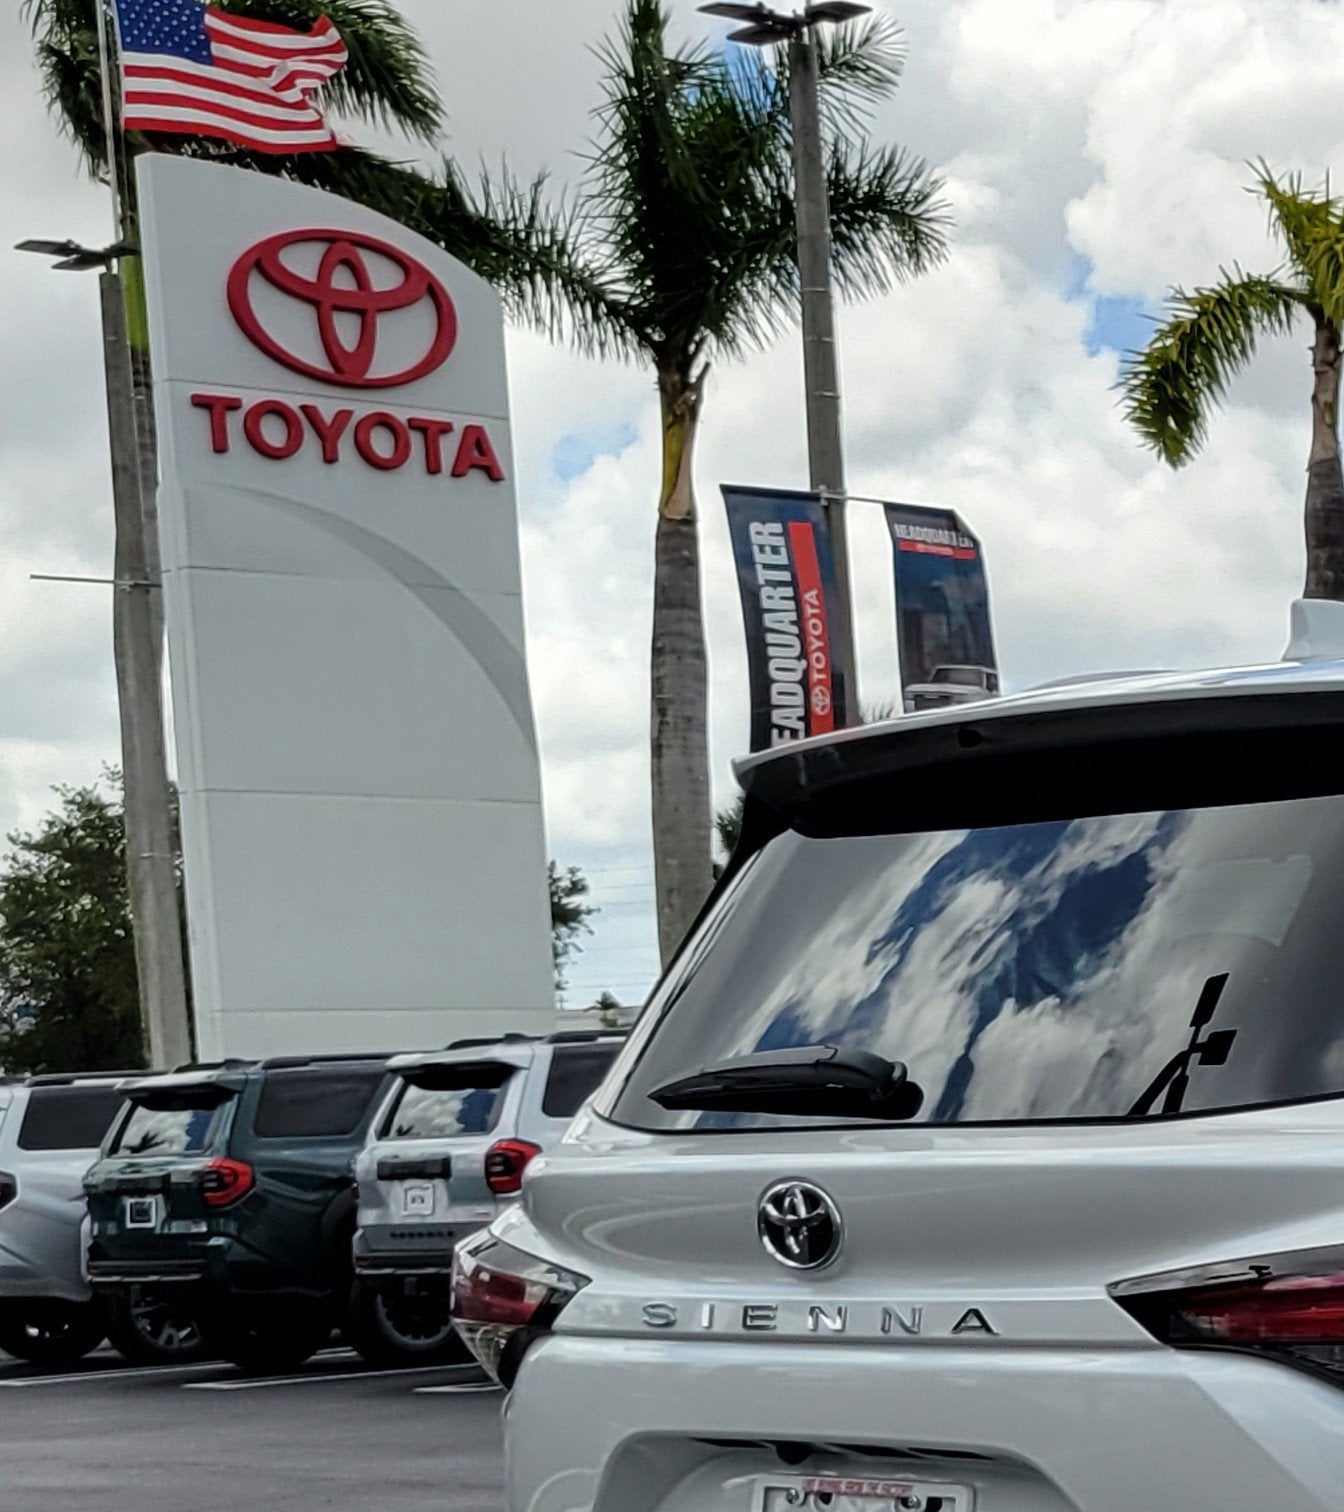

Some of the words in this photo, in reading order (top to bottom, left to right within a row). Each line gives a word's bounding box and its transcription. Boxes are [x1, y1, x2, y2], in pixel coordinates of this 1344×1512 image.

[191, 393, 505, 482] TOYOTA
[749, 521, 807, 748] EADQUARTER
[804, 588, 828, 682] TOYOTA
[642, 1302, 1001, 1336] SIENNA
